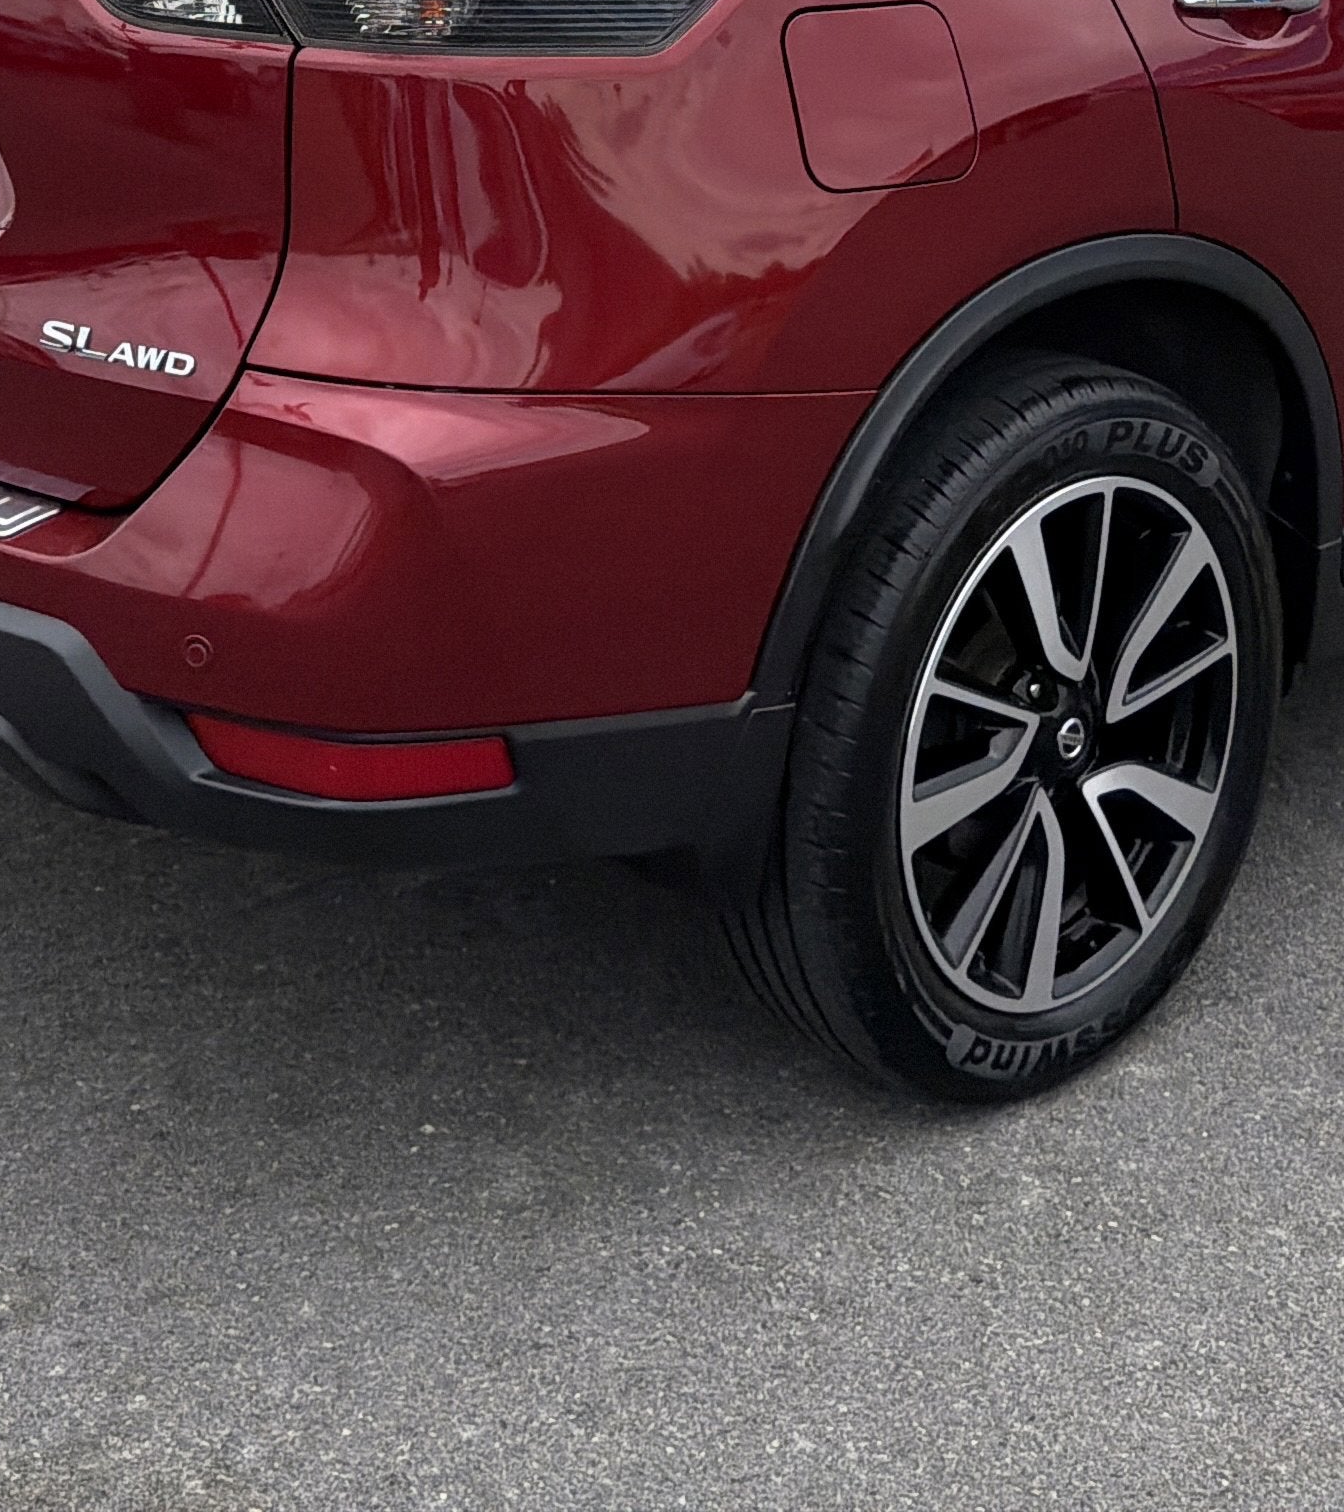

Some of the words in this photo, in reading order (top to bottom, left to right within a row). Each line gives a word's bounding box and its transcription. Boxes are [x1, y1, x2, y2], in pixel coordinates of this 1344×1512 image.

[39, 319, 108, 361] SL
[107, 342, 197, 377] AWD
[1104, 419, 1209, 474] PLUS
